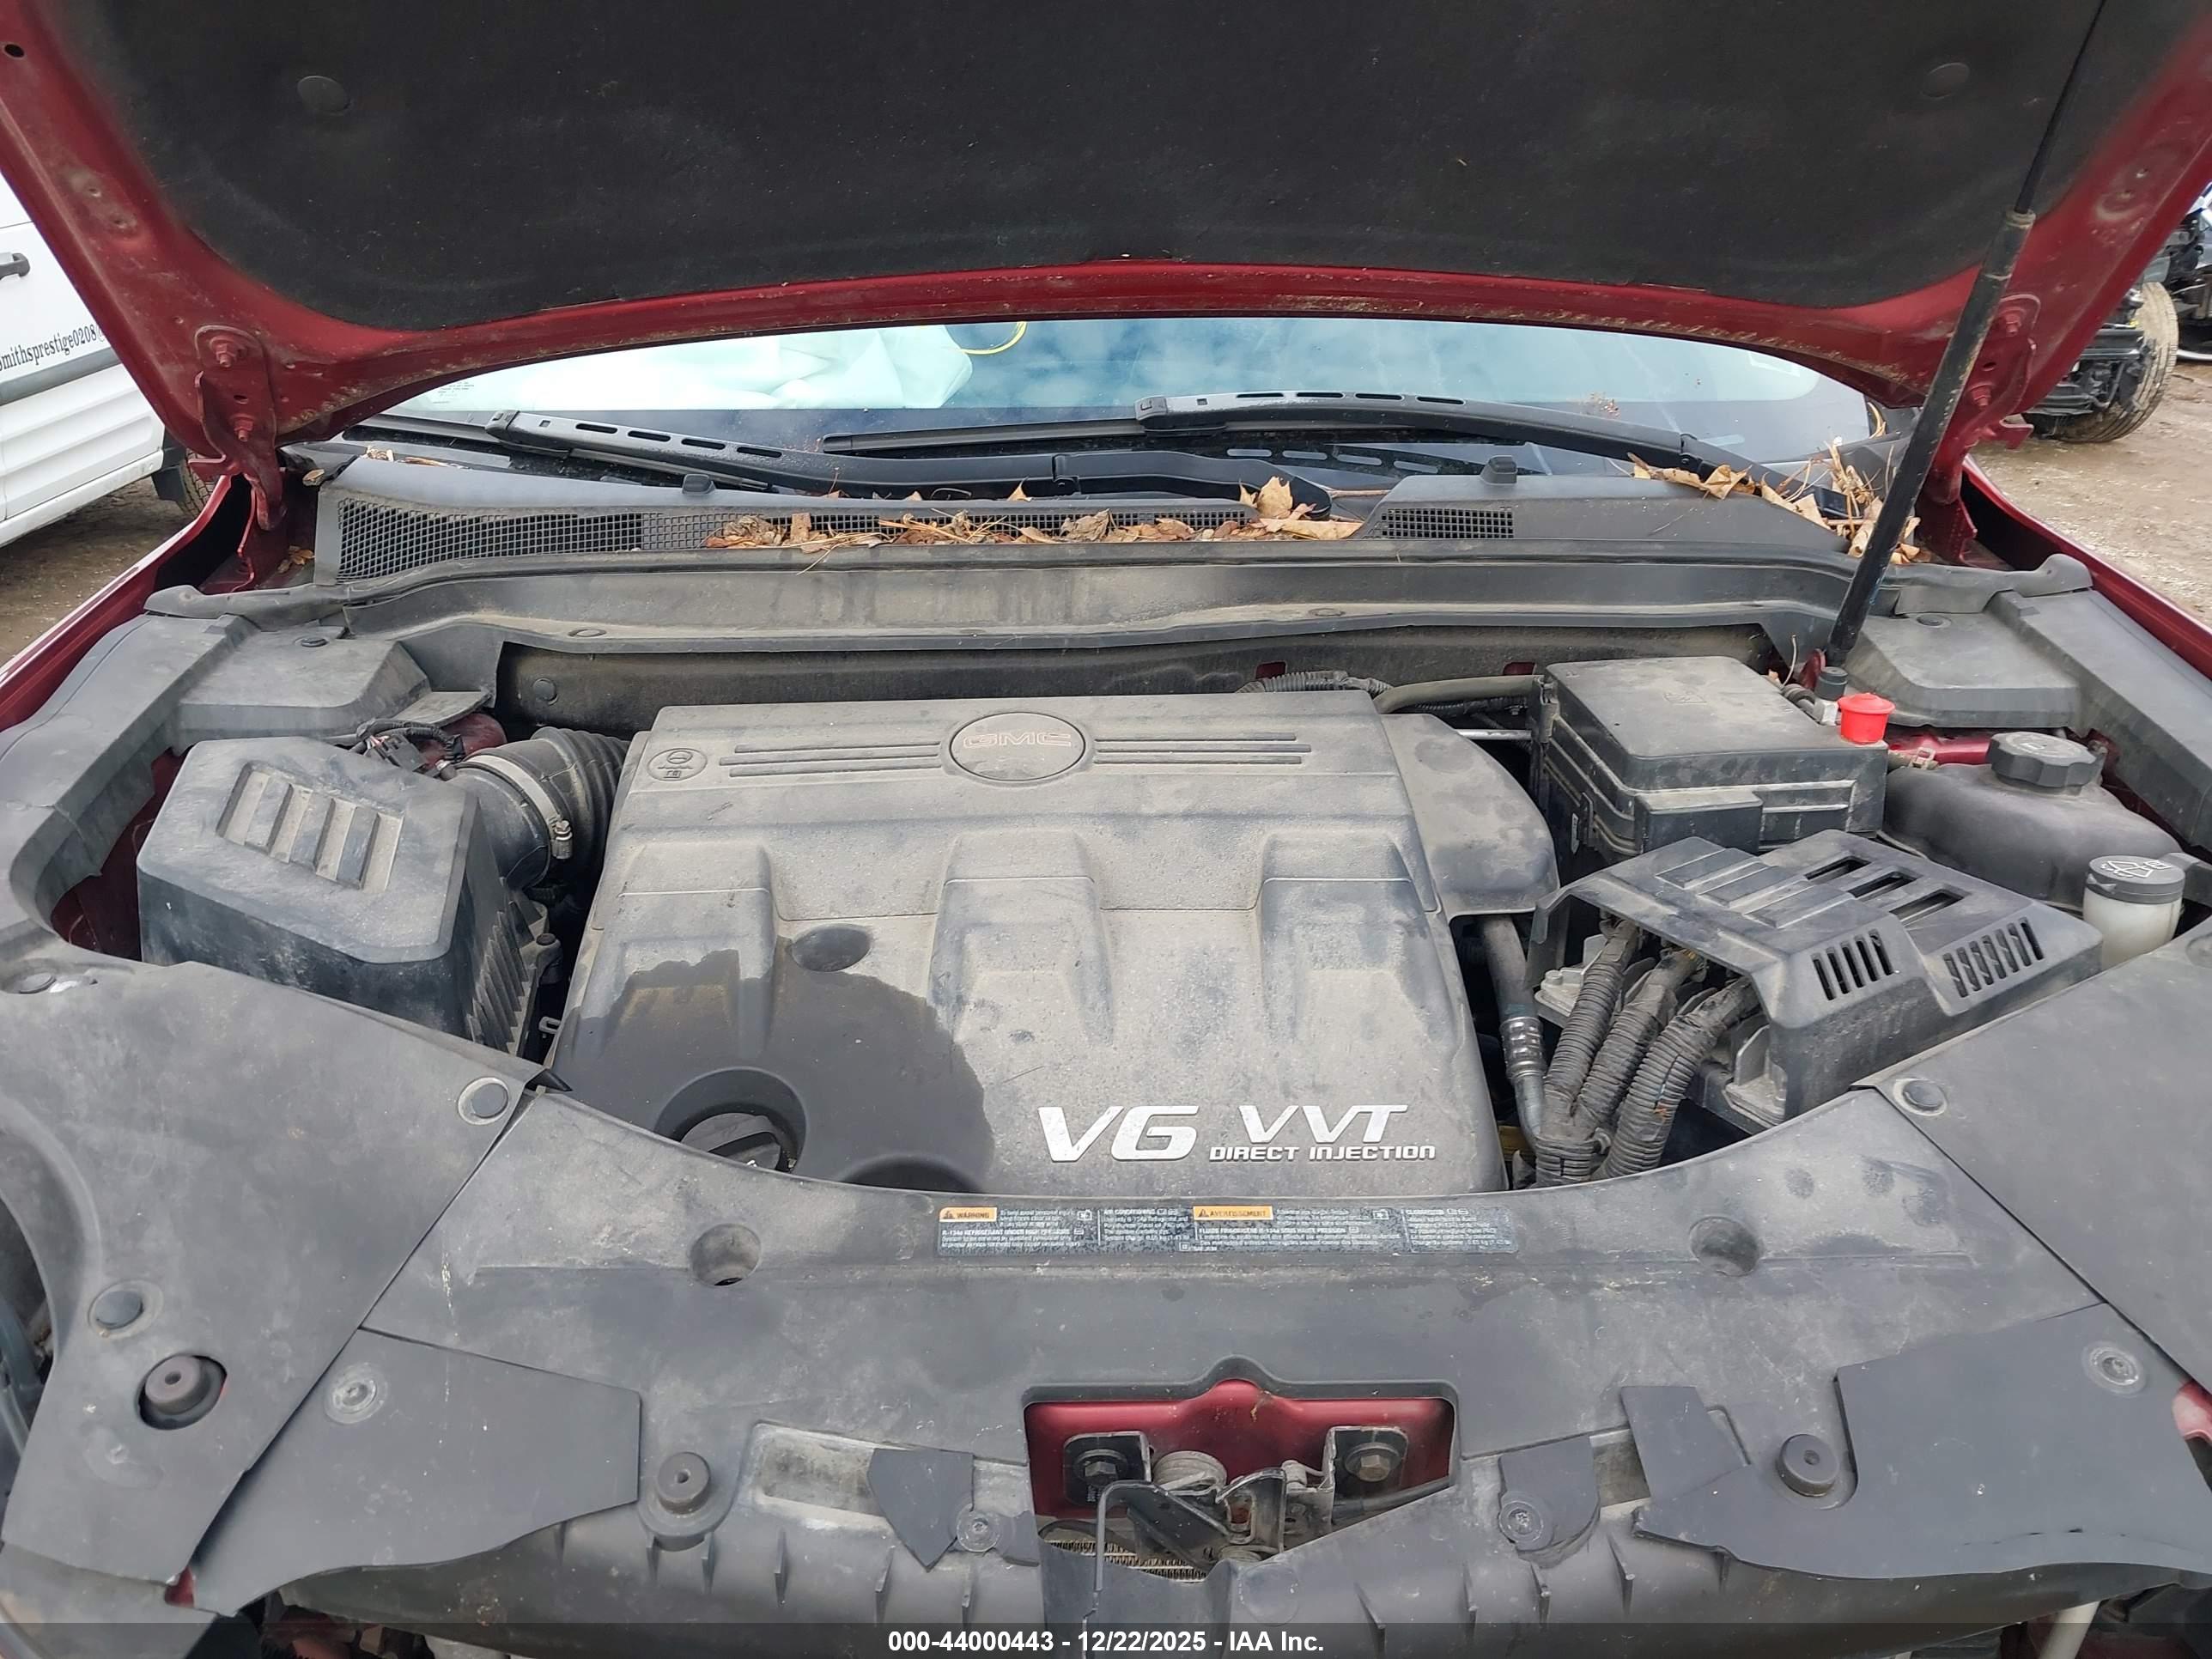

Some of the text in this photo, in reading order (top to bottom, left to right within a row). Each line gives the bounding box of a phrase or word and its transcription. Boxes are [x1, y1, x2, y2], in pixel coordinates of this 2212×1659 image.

[963, 732, 1073, 750] GMC
[1037, 1104, 1408, 1162] V6 VVT
[1209, 1145, 1436, 1162] DIRECT INJECTION
